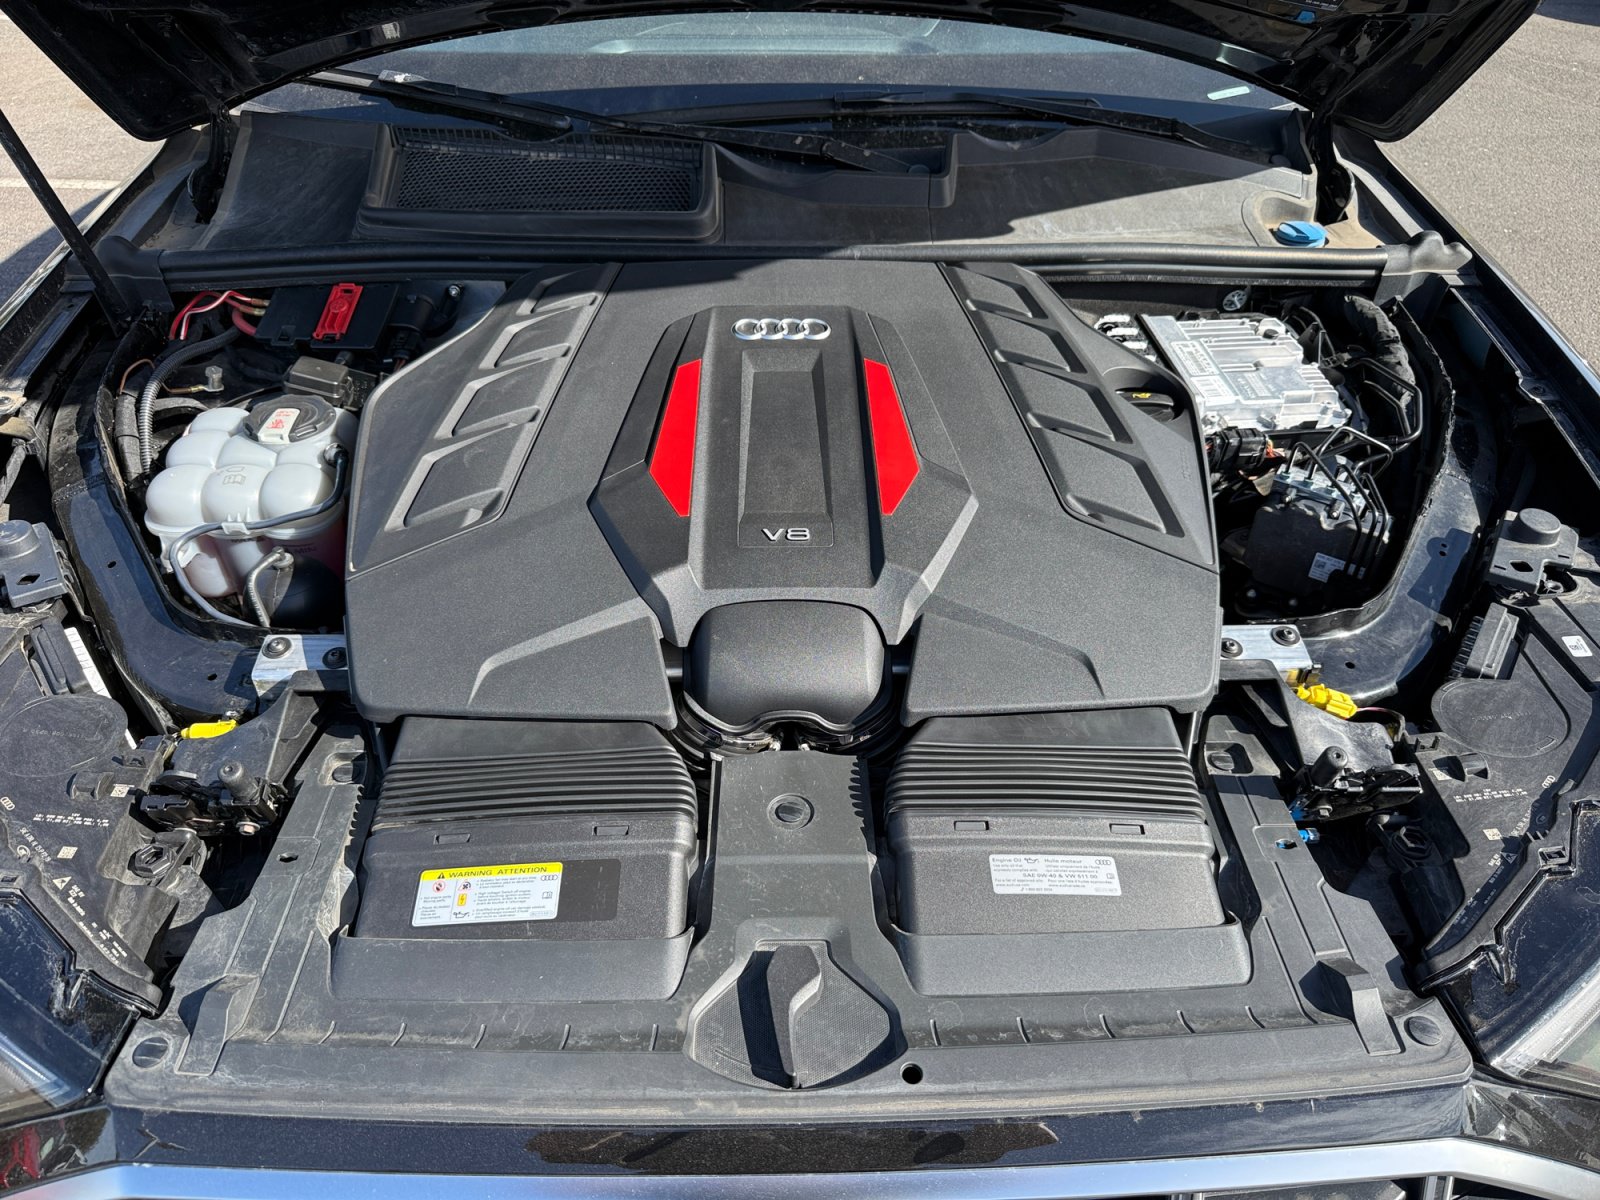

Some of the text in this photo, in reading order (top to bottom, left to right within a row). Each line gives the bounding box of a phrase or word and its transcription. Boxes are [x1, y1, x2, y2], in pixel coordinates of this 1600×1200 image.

[761, 528, 810, 541] V8
[449, 866, 548, 878] WARNING ATTENTION
